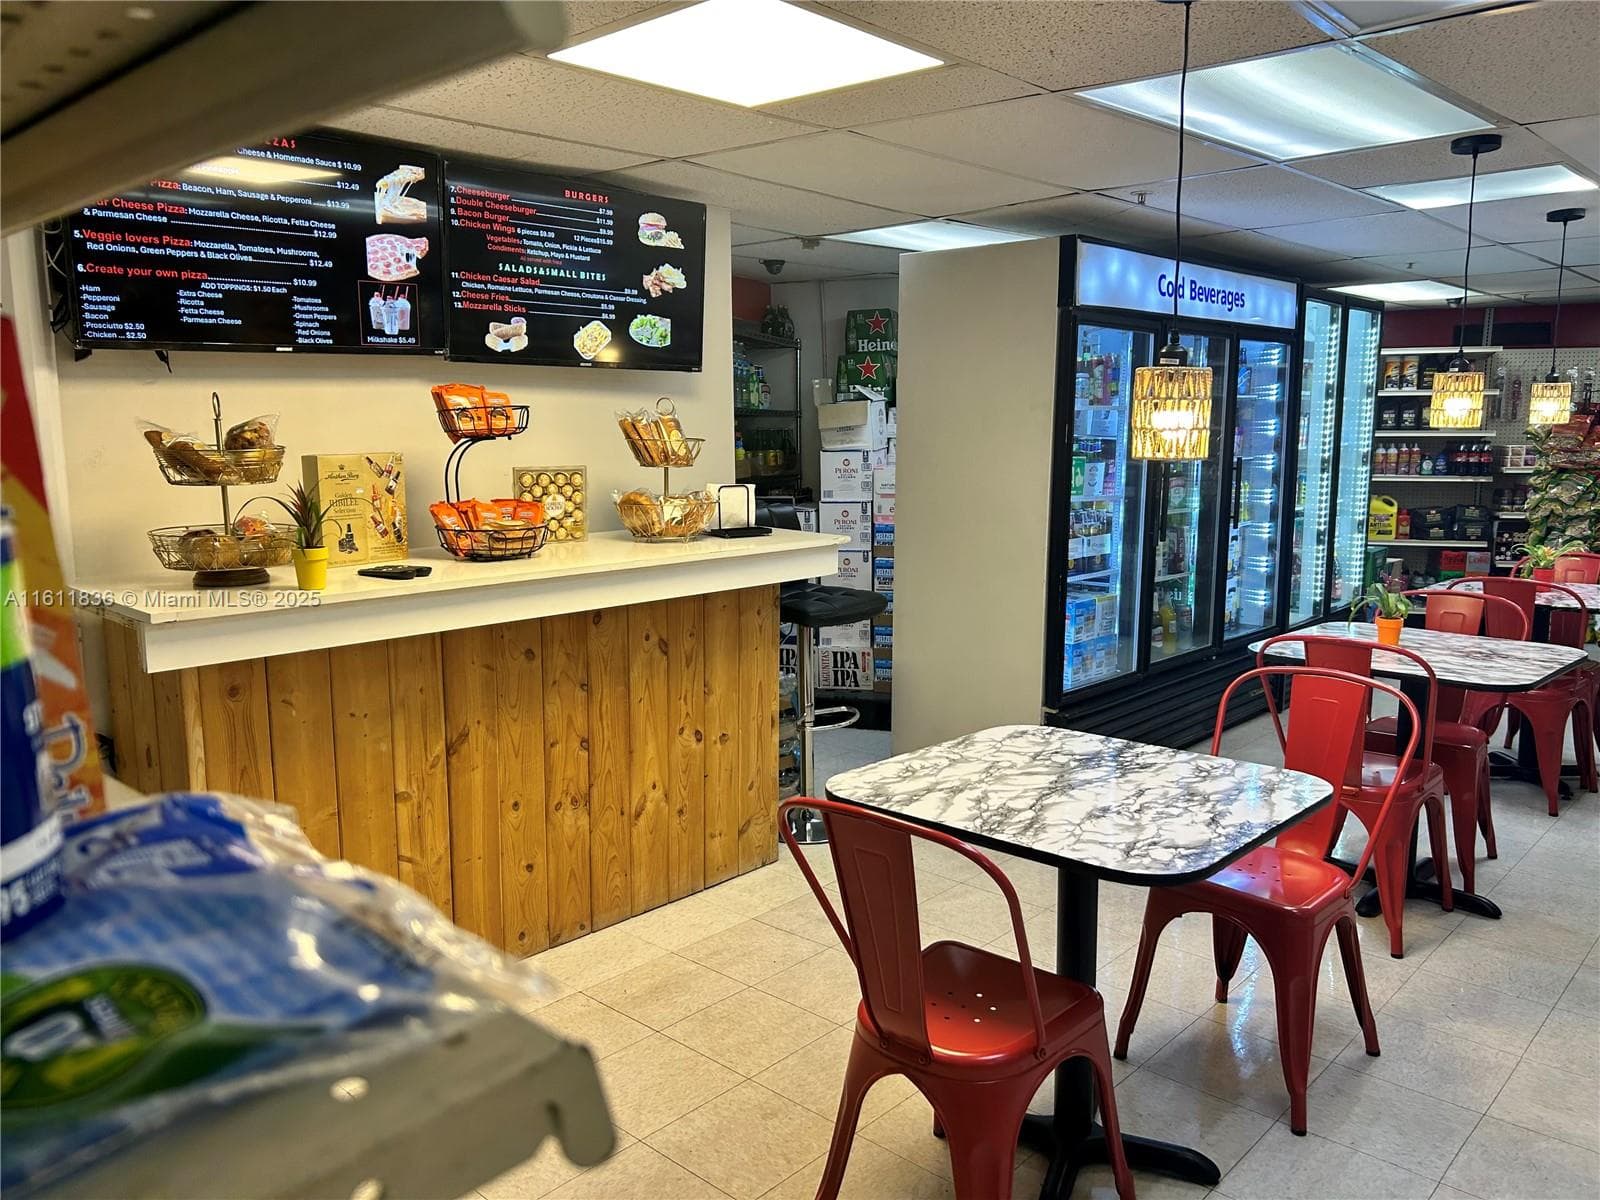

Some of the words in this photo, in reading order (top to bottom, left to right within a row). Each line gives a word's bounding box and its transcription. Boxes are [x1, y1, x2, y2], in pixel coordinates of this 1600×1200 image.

[266, 150, 272, 158] &
[273, 152, 314, 164] Homemade
[315, 159, 337, 168] Sauce
[337, 181, 359, 191] $12.49
[182, 182, 214, 194] Beacon,
[216, 187, 236, 198] Ham,
[237, 189, 269, 201] Sausage
[277, 194, 312, 206] Pepperoni
[564, 190, 609, 204] BURGERS
[112, 197, 154, 211] Cheese
[157, 201, 187, 214] Pizza:
[188, 207, 229, 219] Mozzarella
[230, 212, 261, 222] Cheese,
[262, 214, 290, 225] Ricotta,
[291, 218, 309, 227] Fetta
[310, 220, 336, 230] Cheese
[457, 207, 482, 219] Bacon
[484, 211, 509, 222] Burger
[485, 200, 537, 216] Cheeseburger
[83, 207, 90, 215] &
[92, 208, 135, 219] Parmesan
[135, 212, 168, 223] Cheese
[313, 229, 337, 239] $12.99
[492, 222, 516, 234] Wings
[125, 231, 160, 244] lovers
[163, 235, 193, 247] Pizza:
[194, 240, 237, 251] Mozzarella,
[237, 243, 276, 255] Tomatoes,
[276, 247, 320, 258] Mushrooms,
[86, 242, 105, 250] Red
[140, 246, 165, 255] Green
[166, 248, 199, 258] Peppers
[199, 250, 206, 258] &
[207, 251, 228, 260] Black
[229, 253, 253, 262] Olives
[309, 258, 333, 268] $12.49
[127, 267, 152, 277] your
[155, 270, 178, 278] own
[181, 270, 208, 280] pizza
[293, 278, 317, 287] $10.99
[492, 274, 518, 284] Caesar
[520, 277, 540, 286] Salad
[579, 271, 606, 281] BITES
[200, 281, 216, 290] ADD
[216, 282, 252, 292] TOPPINGS:
[253, 285, 271, 293] $1.50
[271, 286, 288, 294] Each
[487, 283, 511, 292] Romaine
[534, 286, 560, 296] Parmesan
[1158, 274, 1185, 299] Cod
[1190, 279, 1245, 312] Beverages
[197, 290, 223, 299] Cheese
[491, 293, 509, 302] Fries
[199, 307, 225, 316] Cheese
[503, 304, 526, 313] Sticks
[217, 317, 242, 325] Cheese
[313, 313, 337, 321] Peppers
[124, 322, 145, 330] $2.50
[126, 331, 147, 340] $2.50
[367, 335, 398, 344] Milkshake
[398, 336, 416, 344] $5.49
[831, 651, 860, 669] IPA
[821, 650, 832, 688] LAGUNITAS
[832, 669, 860, 688] IPA
